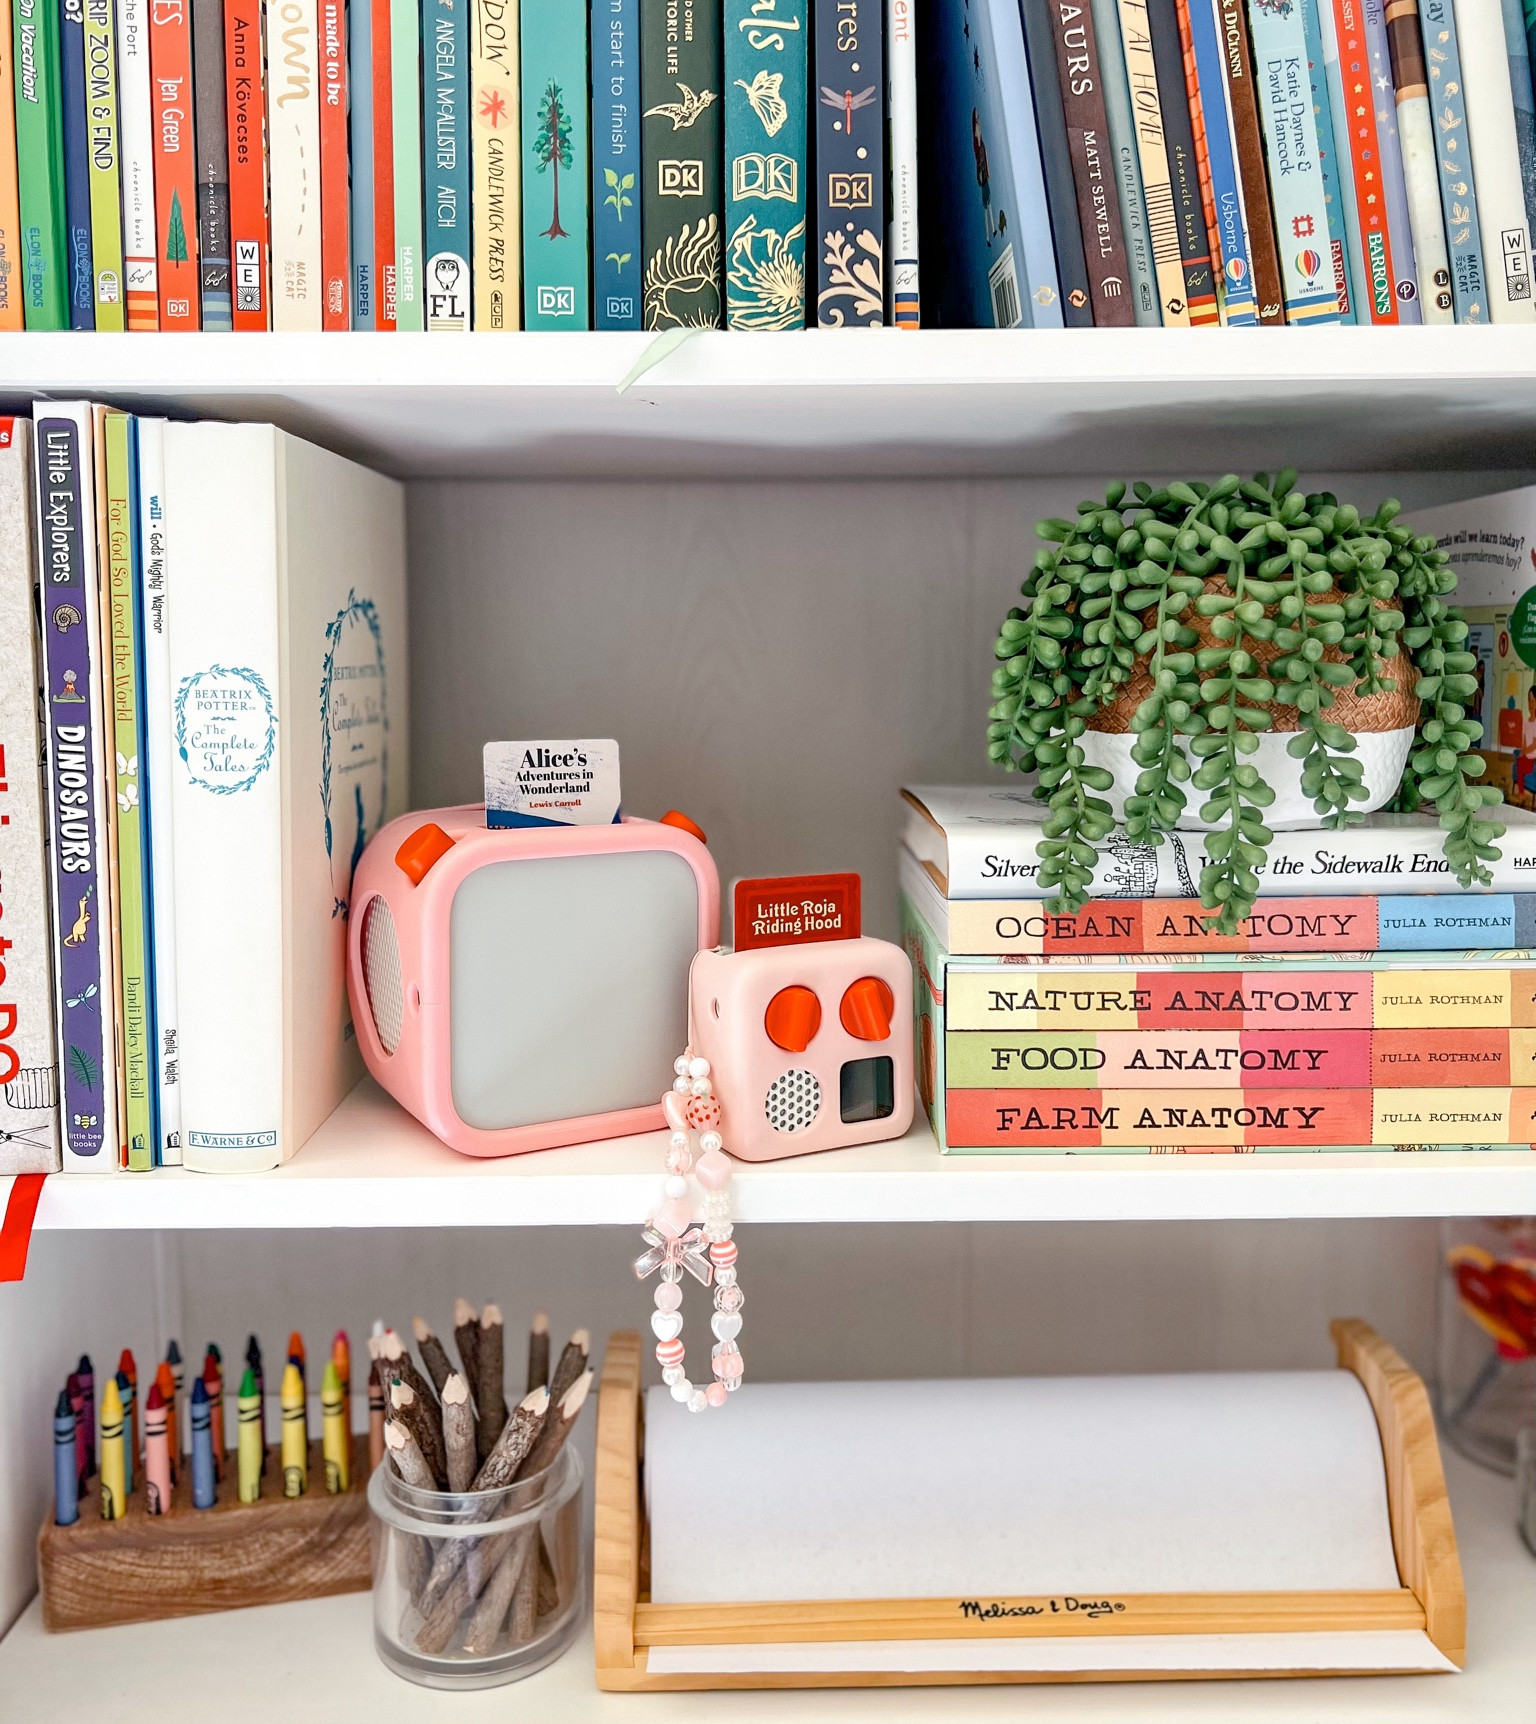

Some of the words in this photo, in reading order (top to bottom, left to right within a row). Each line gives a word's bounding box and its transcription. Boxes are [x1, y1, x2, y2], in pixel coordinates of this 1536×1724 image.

[685, 9, 693, 42] OTHER
[1366, 0, 1378, 26] oke
[127, 25, 138, 56] Port
[234, 17, 249, 68] Anna
[325, 5, 338, 58] made
[610, 20, 625, 68] start
[1128, 28, 1151, 53] AT
[20, 23, 39, 103] Vacation!
[435, 18, 455, 82] ANGELA
[667, 46, 678, 75] LIFE
[1060, 3, 1092, 96] AURS
[90, 34, 110, 100] ZOOM
[326, 62, 338, 80] to
[1267, 60, 1283, 104] David
[1284, 56, 1299, 99] Katie
[157, 76, 183, 102] Jen
[326, 83, 340, 106] be
[611, 75, 625, 96] to
[93, 106, 110, 120] &
[236, 77, 251, 164] Kövecses
[1133, 73, 1162, 146] HOME!
[162, 108, 184, 153] Green
[611, 104, 627, 155] finish
[1274, 109, 1294, 176] Hancock
[1290, 102, 1307, 159] Daynes
[94, 126, 113, 171] FIND
[1083, 130, 1102, 181] MATT
[132, 160, 141, 214] chronicle
[487, 138, 504, 238] CANDLEWICK
[664, 170, 698, 188] DK
[738, 156, 792, 194] DK
[207, 164, 217, 217] chronicle
[835, 182, 867, 199] DK
[1176, 145, 1189, 207] chronicle
[1185, 214, 1196, 251] books
[437, 186, 456, 228] AITCH
[1091, 185, 1113, 258] SEWELL
[1121, 147, 1140, 230] CANDLEWICK
[1134, 238, 1148, 272] PRESS
[209, 219, 217, 252] books
[1221, 192, 1237, 253] Usborne
[30, 227, 41, 257] ELON
[77, 228, 88, 258] ELON
[402, 247, 413, 302] HARPER
[489, 239, 505, 283] PRESS
[1369, 233, 1391, 315] BARRON'S
[1466, 254, 1480, 292] MAGIC
[32, 274, 43, 308] BOOKS
[79, 275, 91, 309] BOOKS
[285, 280, 295, 299] CAT
[296, 261, 307, 299] MAGIC
[360, 265, 369, 317] HARPER
[386, 265, 396, 320] HARPER
[1298, 286, 1324, 294] USBORNE
[1459, 275, 1469, 293] CAT
[170, 302, 186, 315] DK
[430, 295, 465, 318] FL
[542, 293, 569, 309] DK
[610, 301, 629, 314] DK
[47, 430, 71, 484] Little
[110, 498, 126, 525] For
[150, 495, 162, 520] will
[46, 491, 75, 583] Explorers
[111, 531, 128, 562] God
[1479, 529, 1498, 545] learn
[1499, 532, 1525, 552] today?
[112, 567, 129, 587] So
[148, 559, 164, 590] Mighty
[112, 594, 130, 644] Loved
[151, 593, 163, 634] Warrior
[113, 644, 131, 671] the
[115, 673, 133, 722] World
[195, 689, 252, 699] BEATRIX
[191, 731, 258, 752] Complete
[203, 724, 226, 735] The
[203, 753, 249, 773] Tales
[520, 747, 588, 769] Alice's
[515, 769, 580, 783] Adventures
[582, 769, 594, 780] in
[519, 781, 590, 795] Wonderland
[56, 724, 91, 874] DINOSAURS
[529, 800, 552, 808] Lewis
[554, 799, 582, 808] Carroll
[1273, 854, 1304, 875] the
[1310, 850, 1404, 874] Sidewalk
[752, 916, 802, 935] Riding
[804, 913, 842, 931] Hood
[757, 901, 798, 918] Little
[801, 900, 836, 917] Roja
[1383, 918, 1427, 929] JULIA
[1434, 916, 1512, 928] ROTHMAN
[995, 915, 1135, 938] OCEAN
[1156, 914, 1358, 938] ANTOMY
[127, 976, 141, 1013] Dandi
[988, 989, 1152, 1012] NATURE
[1164, 990, 1358, 1012] ANATOMY
[1381, 995, 1423, 1005] JULIA
[1429, 994, 1504, 1005] ROTHMAN
[128, 1016, 142, 1049] Daley
[165, 1029, 177, 1055] Sheila
[165, 1059, 178, 1085] Walsh
[990, 1047, 1106, 1071] FOOD
[1124, 1049, 1328, 1070] ANATOMY
[1379, 1053, 1421, 1063] JULIA
[1427, 1052, 1502, 1063] ROTHMAN
[130, 1052, 145, 1099] Mackall
[996, 1107, 1120, 1131] FARM
[1133, 1106, 1325, 1129] ANATOMY
[1381, 1113, 1422, 1123] JULIA
[1428, 1112, 1503, 1123] ROTHMAN
[69, 1132, 86, 1140] little
[73, 1140, 97, 1148] books
[191, 1134, 199, 1144] F.
[201, 1134, 243, 1146] WARNE
[245, 1135, 256, 1146] &
[959, 1600, 1044, 1622] Melissa
